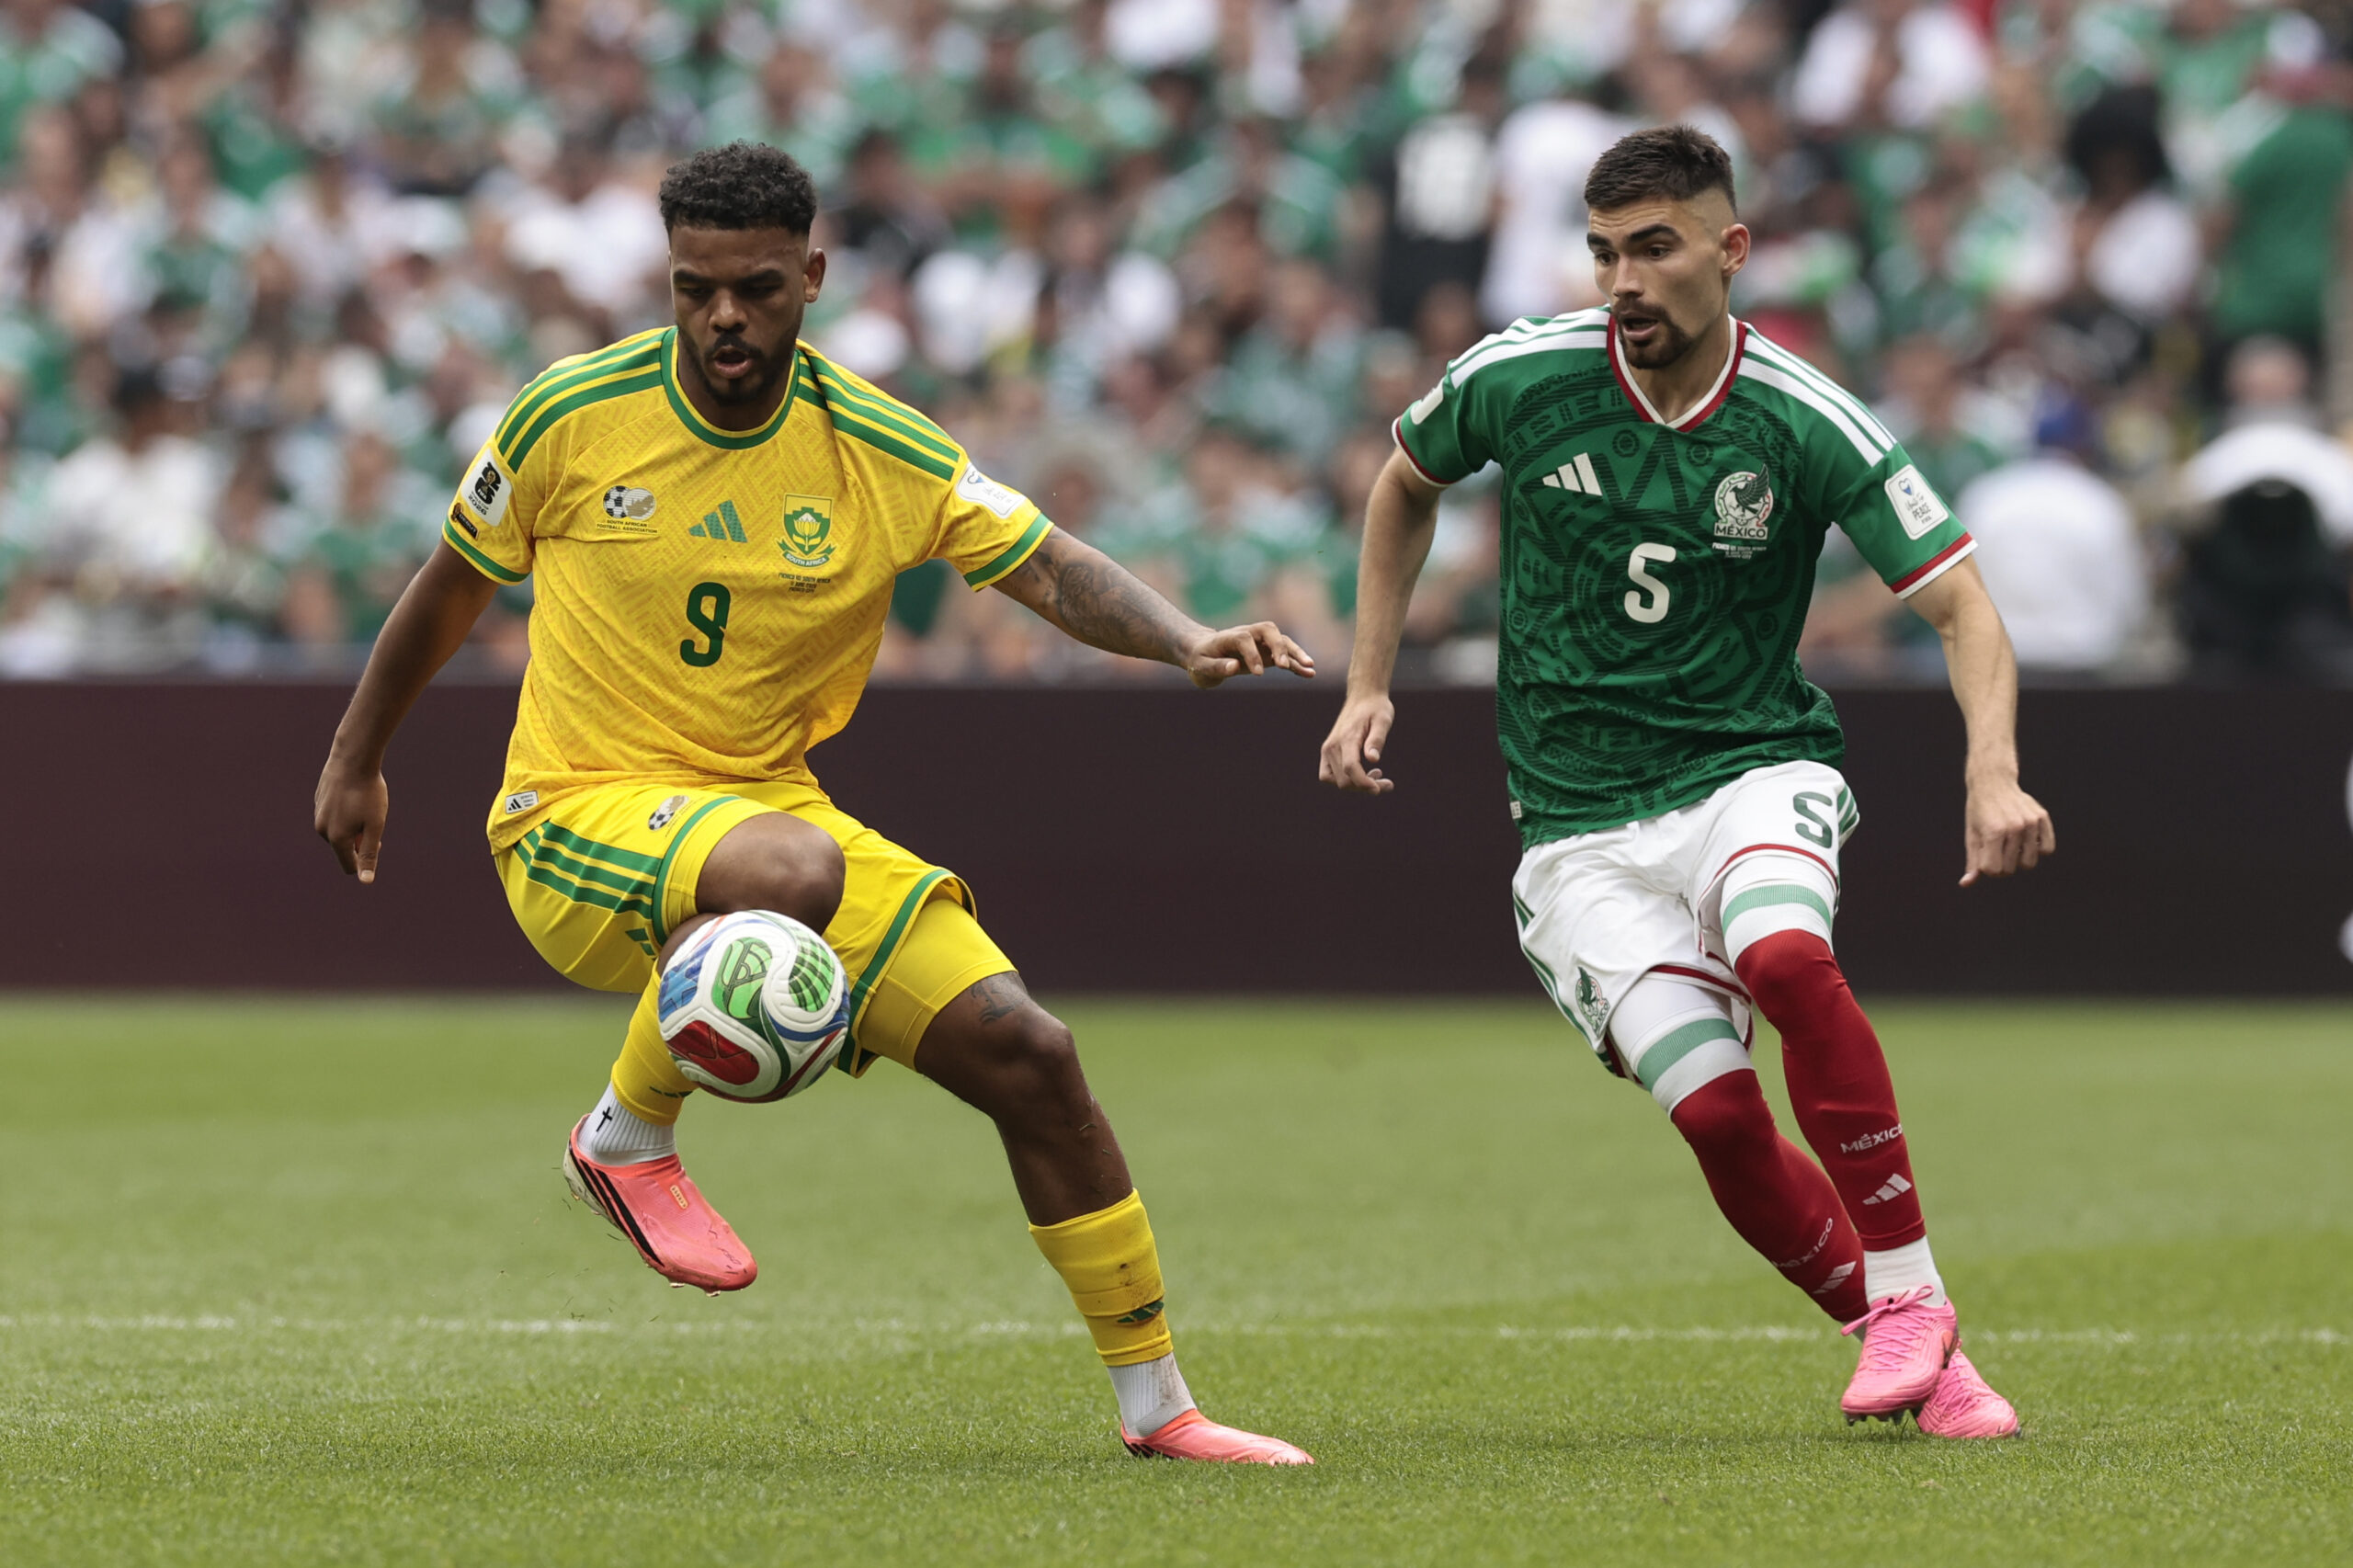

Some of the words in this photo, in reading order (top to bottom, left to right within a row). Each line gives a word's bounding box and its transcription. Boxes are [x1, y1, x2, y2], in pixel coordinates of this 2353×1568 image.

[468, 494, 487, 516] 2026
[1912, 502, 1932, 521] PEACE
[1715, 524, 1767, 539] MÉXICO
[786, 553, 805, 566] SOUTH
[805, 556, 827, 566] AFRICA
[1624, 542, 1677, 623] 5
[680, 582, 731, 667] 9
[1792, 791, 1833, 848] 5
